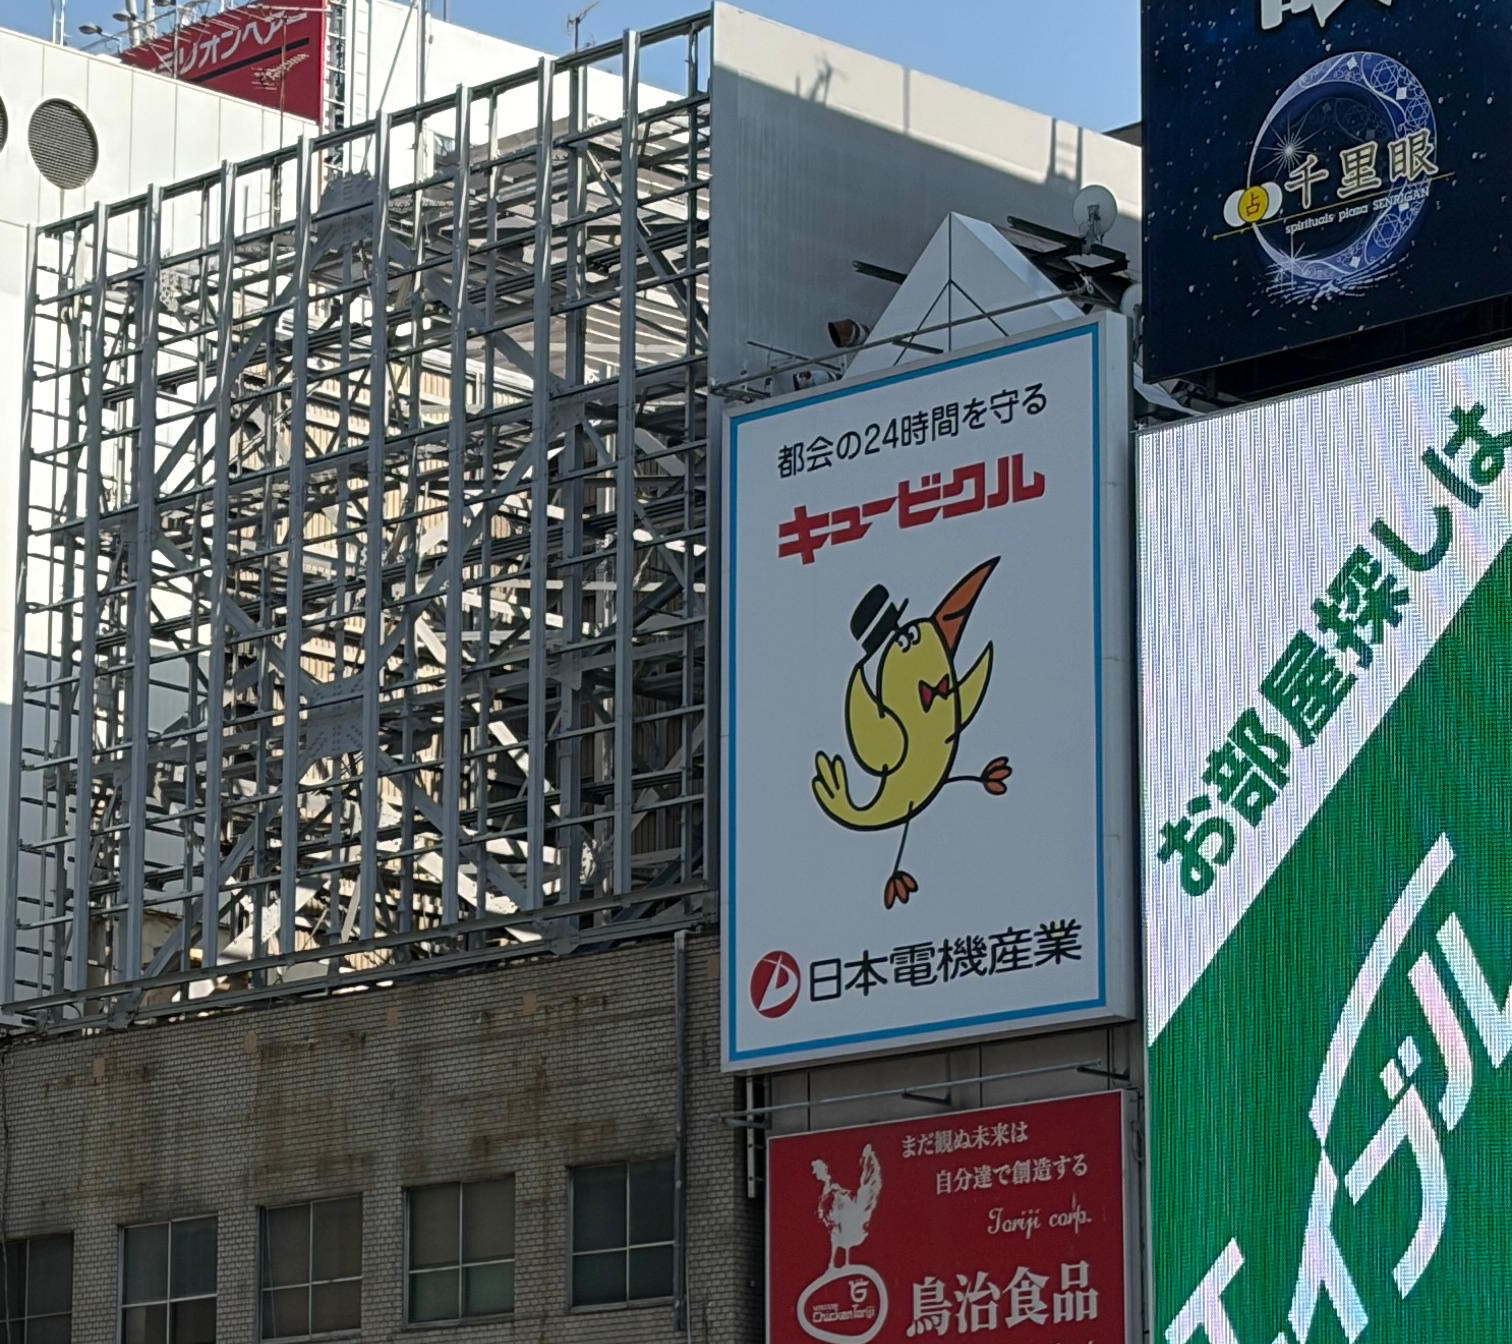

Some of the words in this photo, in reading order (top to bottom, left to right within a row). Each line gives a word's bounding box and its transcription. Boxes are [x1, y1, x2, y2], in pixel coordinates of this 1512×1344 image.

[1246, 193, 1261, 217] 占
[1285, 127, 1439, 209] 千里眼
[1285, 213, 1334, 234] spirituals
[1373, 187, 1430, 211] SENRIGAN
[777, 383, 1047, 478] 都会の24時間を守る
[778, 453, 1045, 565] キュービクル
[1157, 402, 1512, 897] お部屋探しは
[809, 918, 1082, 1002] 日本電機産業
[902, 1122, 1029, 1158] まだ観ぬ未来は
[936, 1154, 1088, 1195] 自分達で創造する
[906, 1260, 1099, 1337] 鳥治食品
